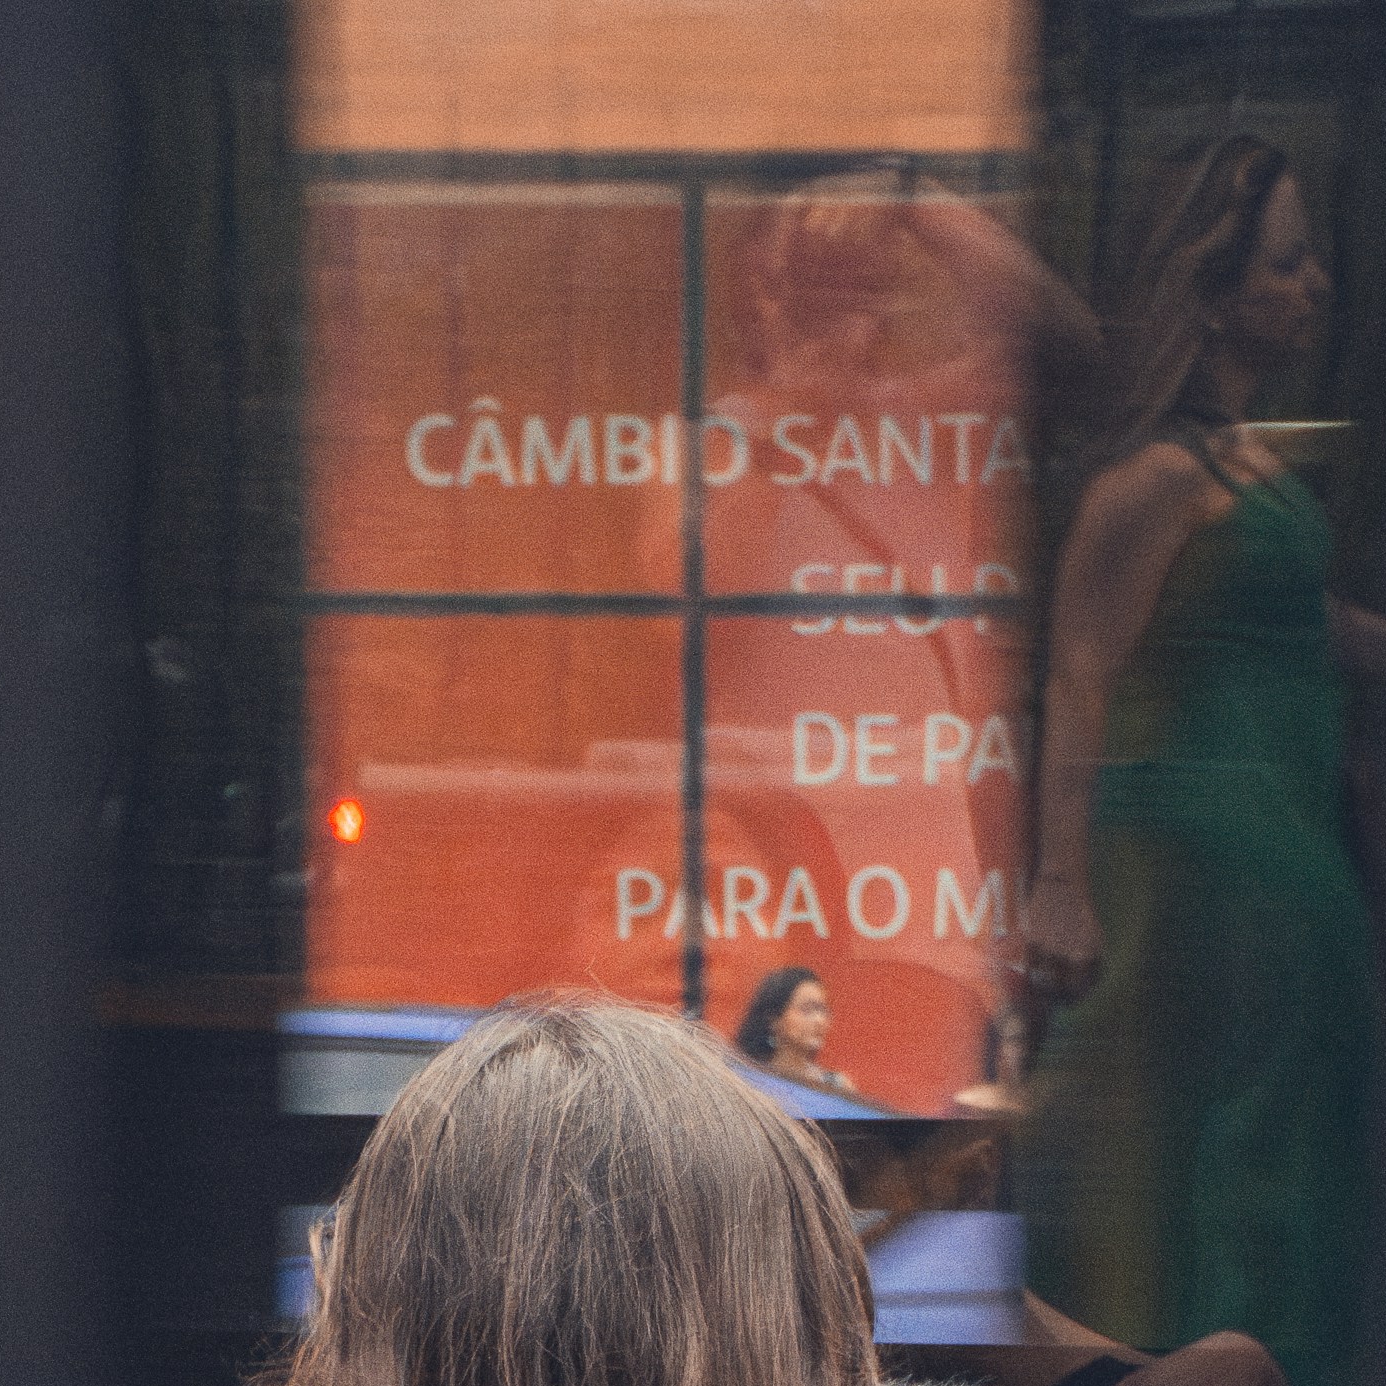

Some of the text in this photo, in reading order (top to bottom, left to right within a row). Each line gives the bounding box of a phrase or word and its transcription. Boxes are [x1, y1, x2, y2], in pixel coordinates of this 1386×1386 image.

[406, 398, 1030, 489] CÂMBIO SANTA
[791, 563, 942, 634] SEU
[792, 712, 1017, 787] DE PA
[616, 866, 1028, 941] PARA O M
